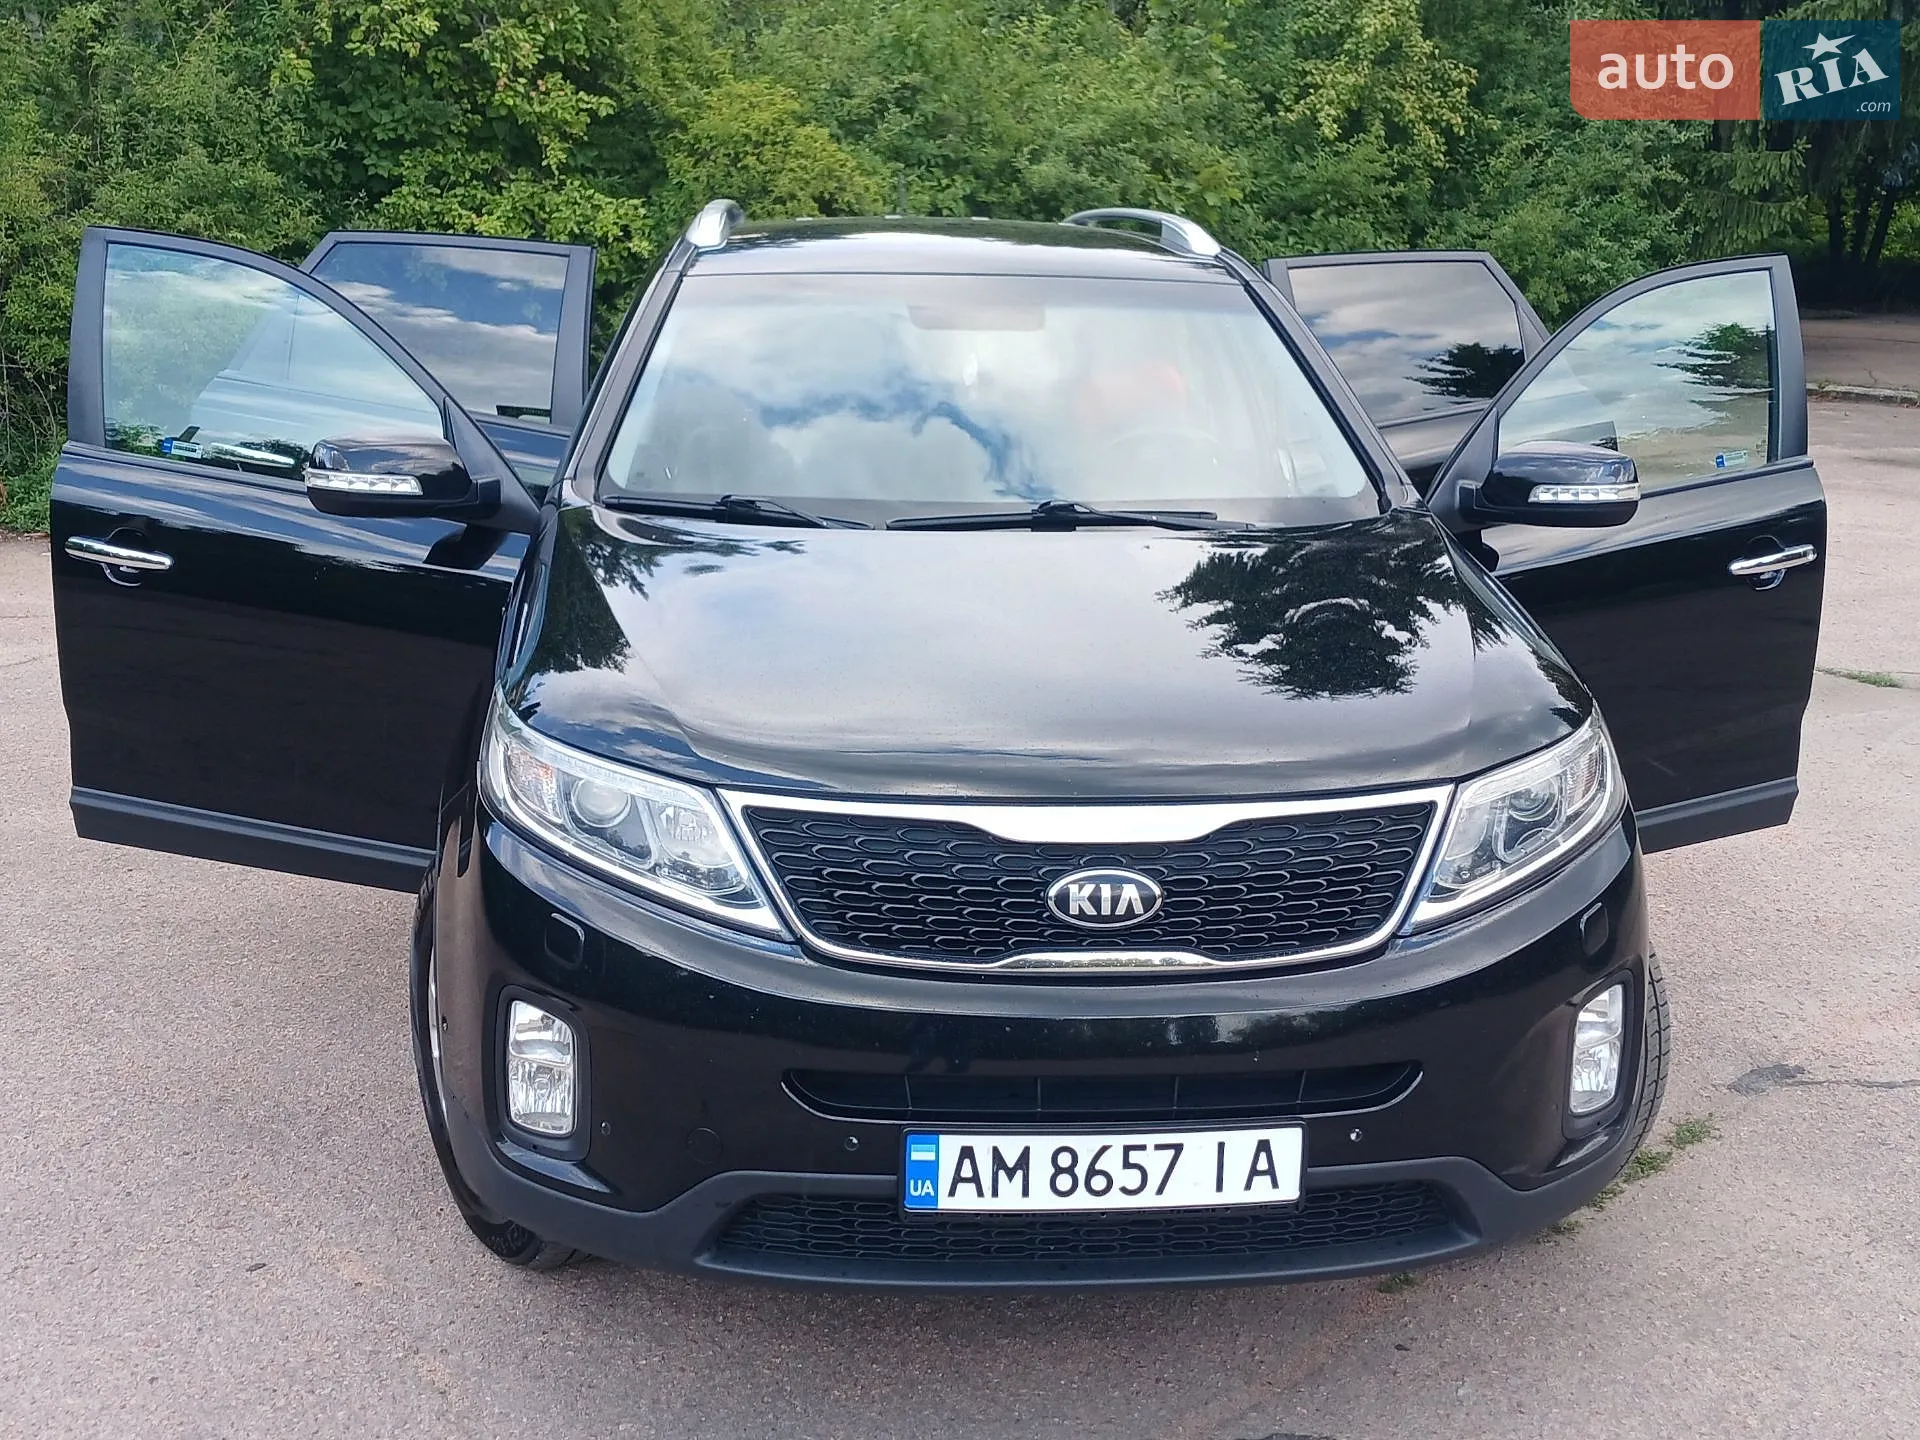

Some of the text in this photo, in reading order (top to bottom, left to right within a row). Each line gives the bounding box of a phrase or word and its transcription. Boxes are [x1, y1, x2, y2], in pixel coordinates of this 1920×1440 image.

[1068, 883, 1144, 916] KIA
[948, 1145, 1030, 1198] AM
[1049, 1142, 1184, 1197] 8657
[910, 1179, 935, 1197] UA
